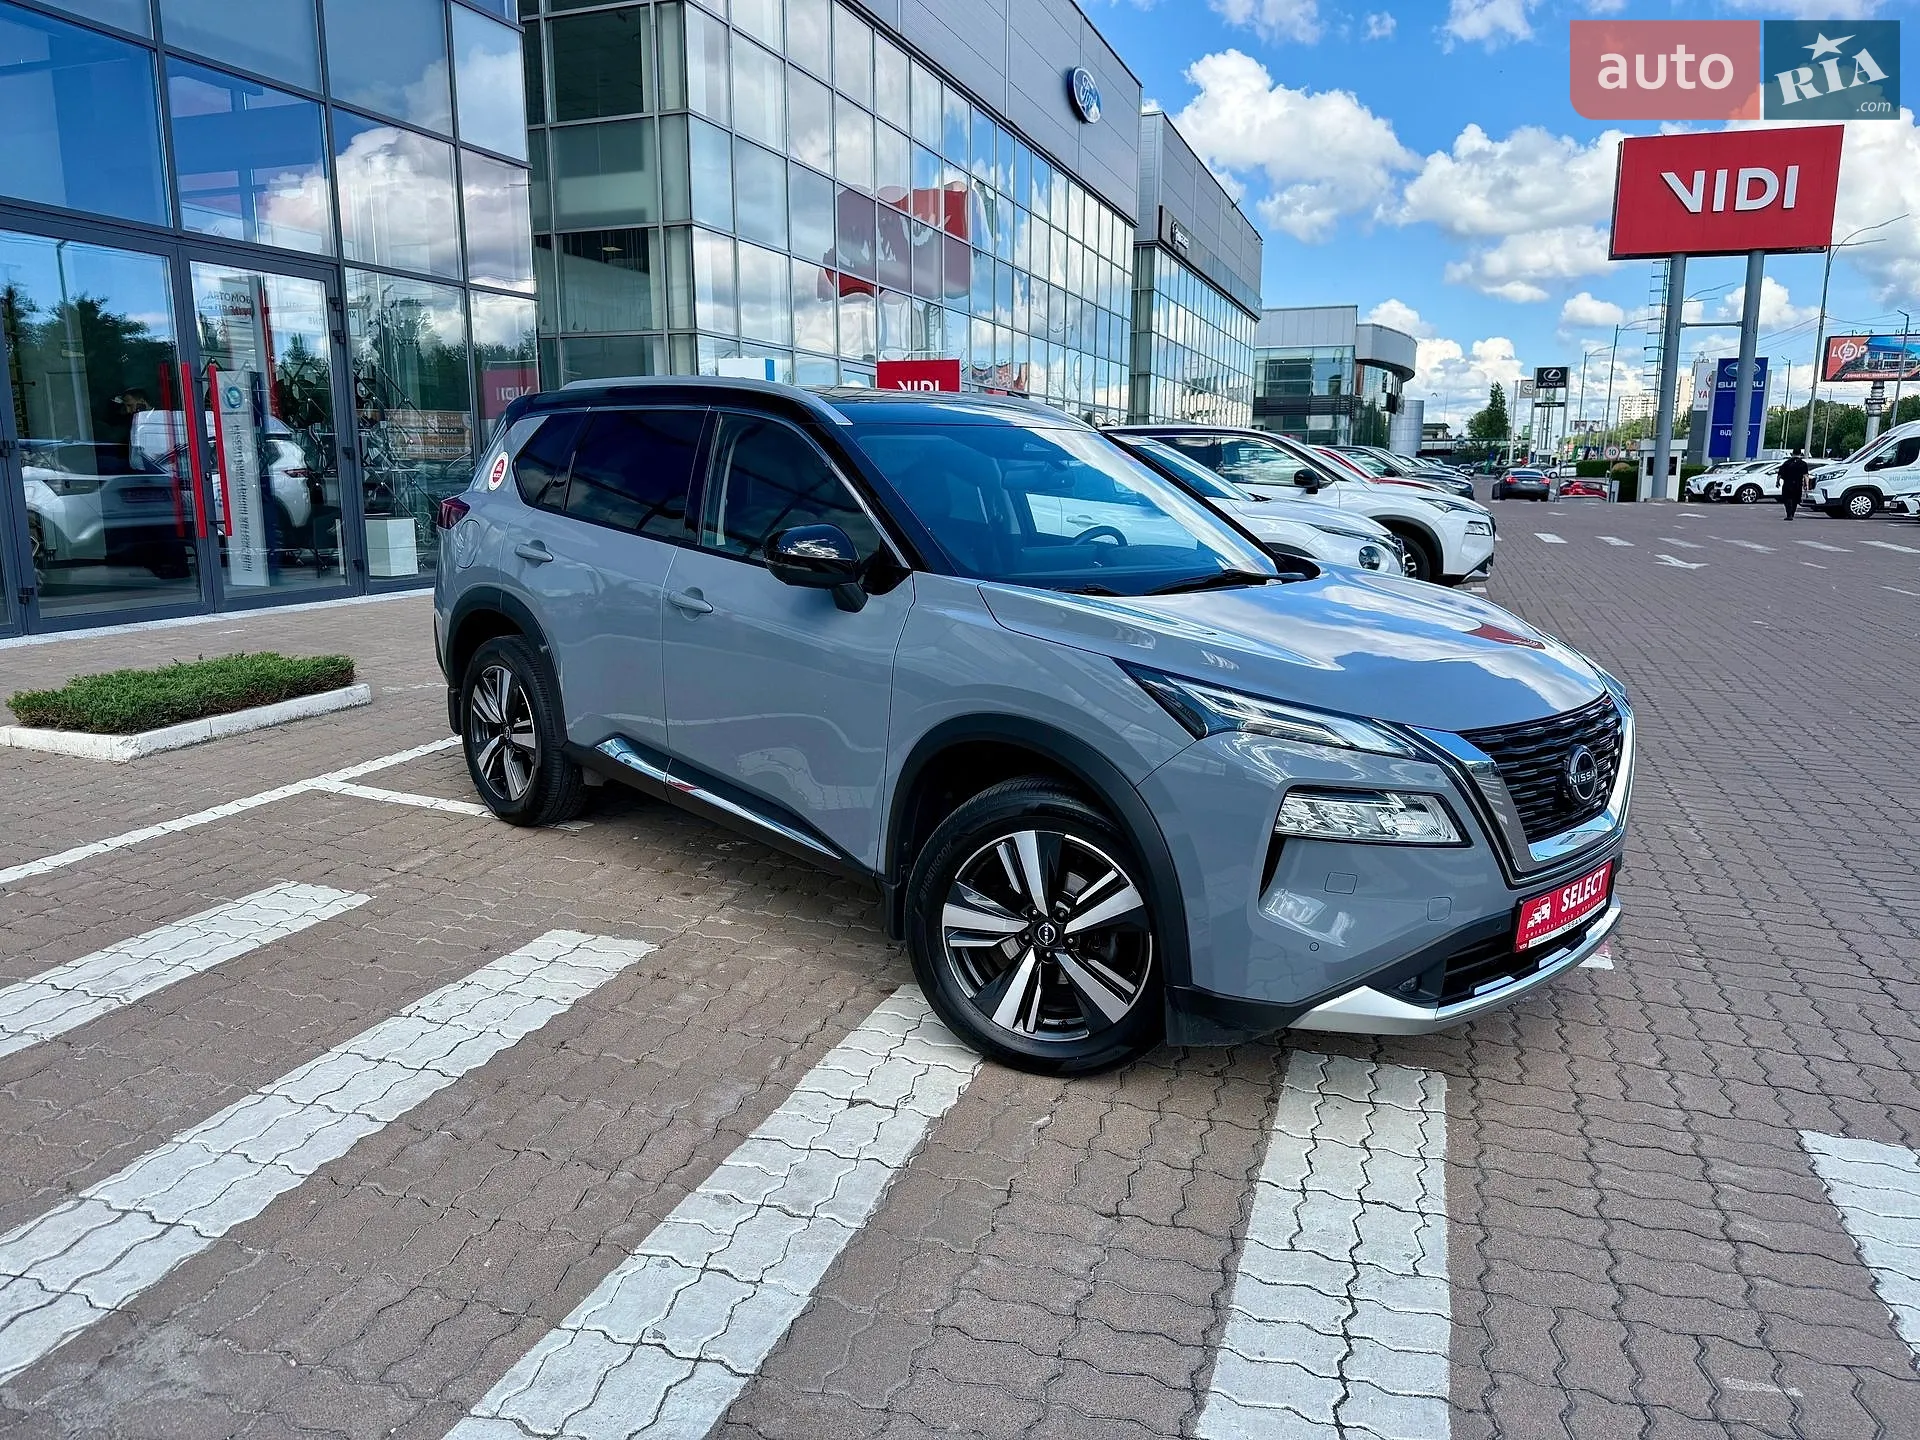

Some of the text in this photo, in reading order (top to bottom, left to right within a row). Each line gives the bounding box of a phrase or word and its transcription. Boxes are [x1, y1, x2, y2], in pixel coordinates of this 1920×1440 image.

[1661, 165, 1799, 213] VIDI
[1569, 770, 1595, 785] NISSA
[1561, 867, 1607, 912] SELECT
